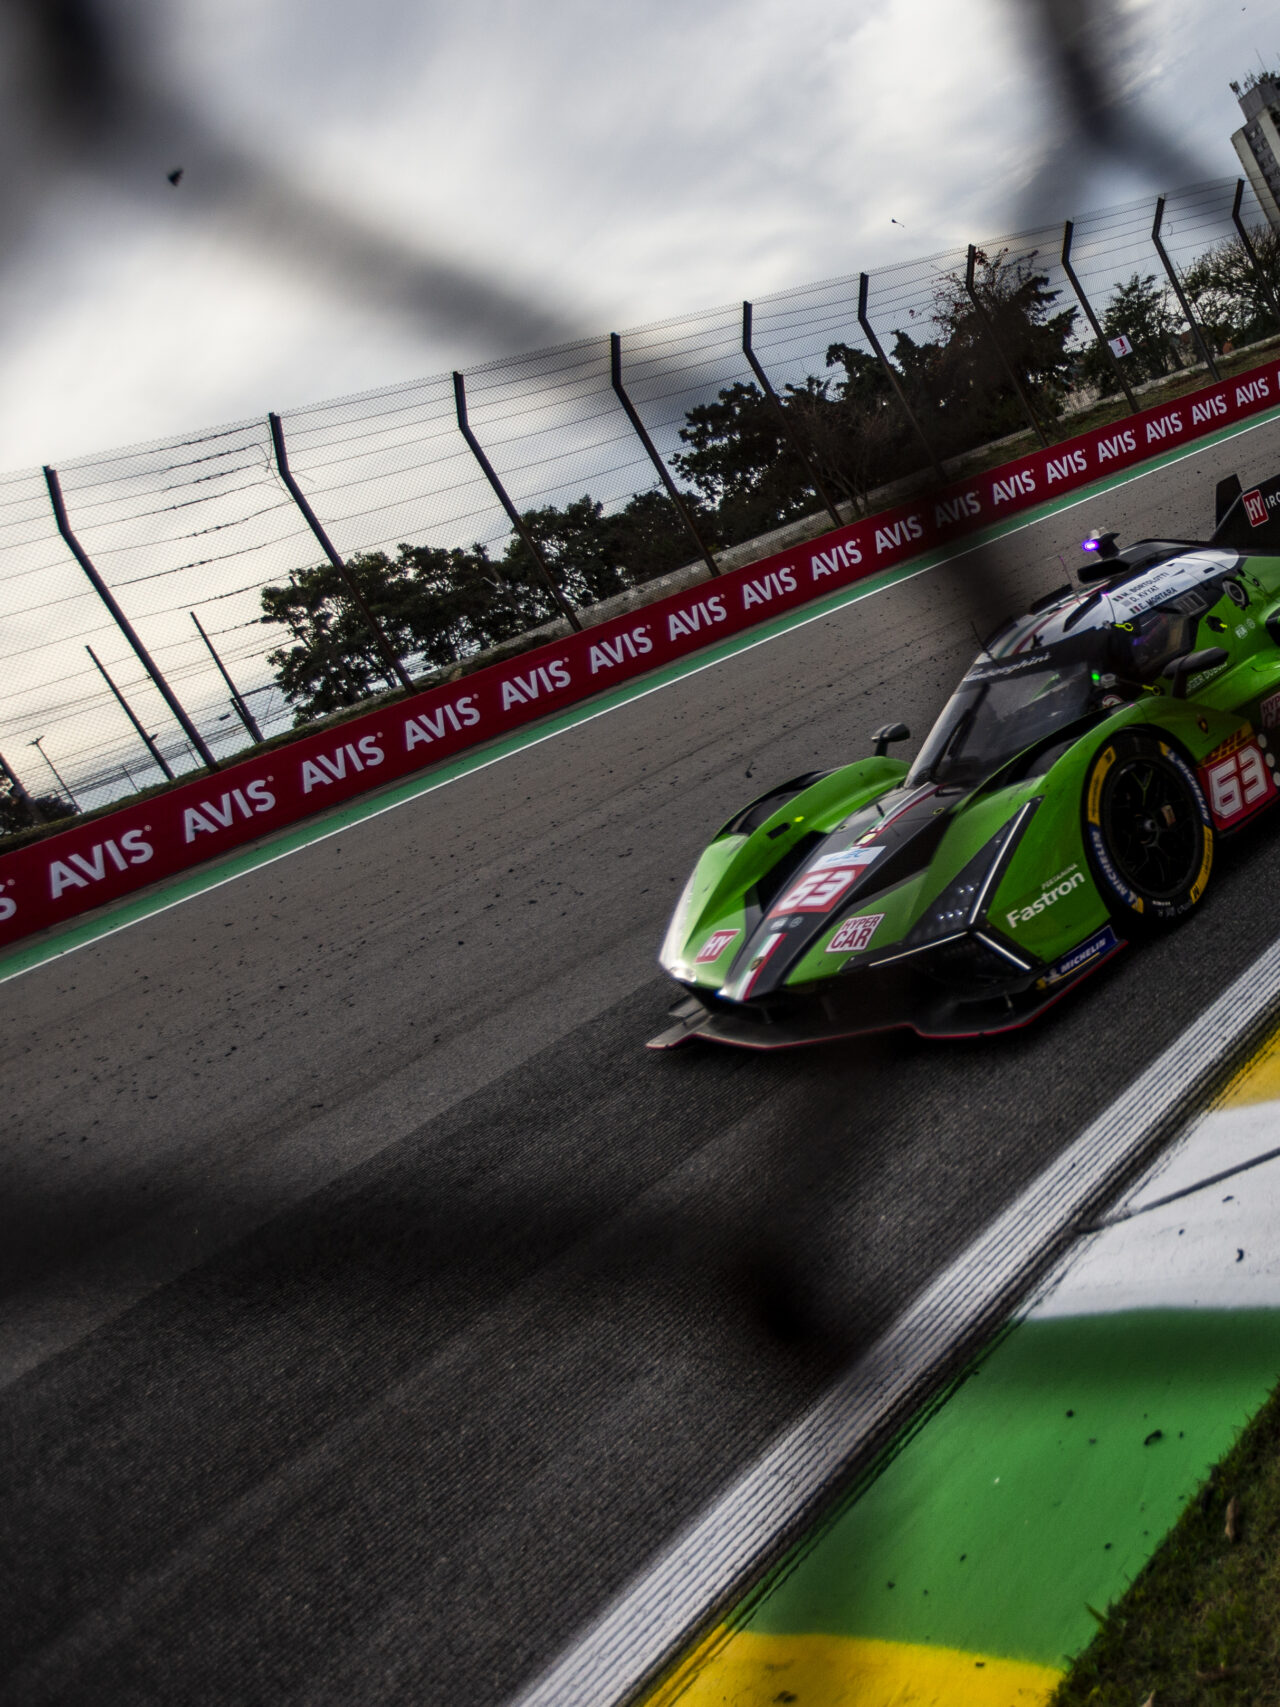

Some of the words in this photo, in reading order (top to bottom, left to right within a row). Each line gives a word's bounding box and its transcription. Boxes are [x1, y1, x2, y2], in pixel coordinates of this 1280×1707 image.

[1246, 497, 1266, 523] HY
[1146, 587, 1177, 607] MORTARA
[49, 830, 154, 899] AVIS
[184, 780, 276, 842] AVIS
[301, 736, 385, 793] AVIS
[404, 697, 480, 751] AVIS
[500, 660, 571, 709] AVIS
[589, 627, 653, 674] AVIS
[667, 596, 727, 641] AVIS
[741, 568, 797, 609] AVIS
[810, 541, 862, 580] AVIS
[874, 516, 923, 554] AVIS
[935, 493, 981, 528] AVIS
[992, 470, 1036, 505] AVIS
[1045, 450, 1087, 484] AVIS
[1097, 431, 1136, 463] AVIS
[1146, 412, 1183, 444] AVIS
[1191, 395, 1227, 425] AVIS
[1235, 378, 1269, 407] AVIS
[1208, 745, 1268, 818] 63
[1092, 830, 1129, 897] MICHELIN
[779, 870, 856, 911] 63
[1006, 872, 1085, 928] Fastron
[831, 926, 873, 951] CAR
[841, 915, 880, 930] HYPER
[699, 934, 731, 958] HY
[1060, 938, 1106, 973] MICHELIN
